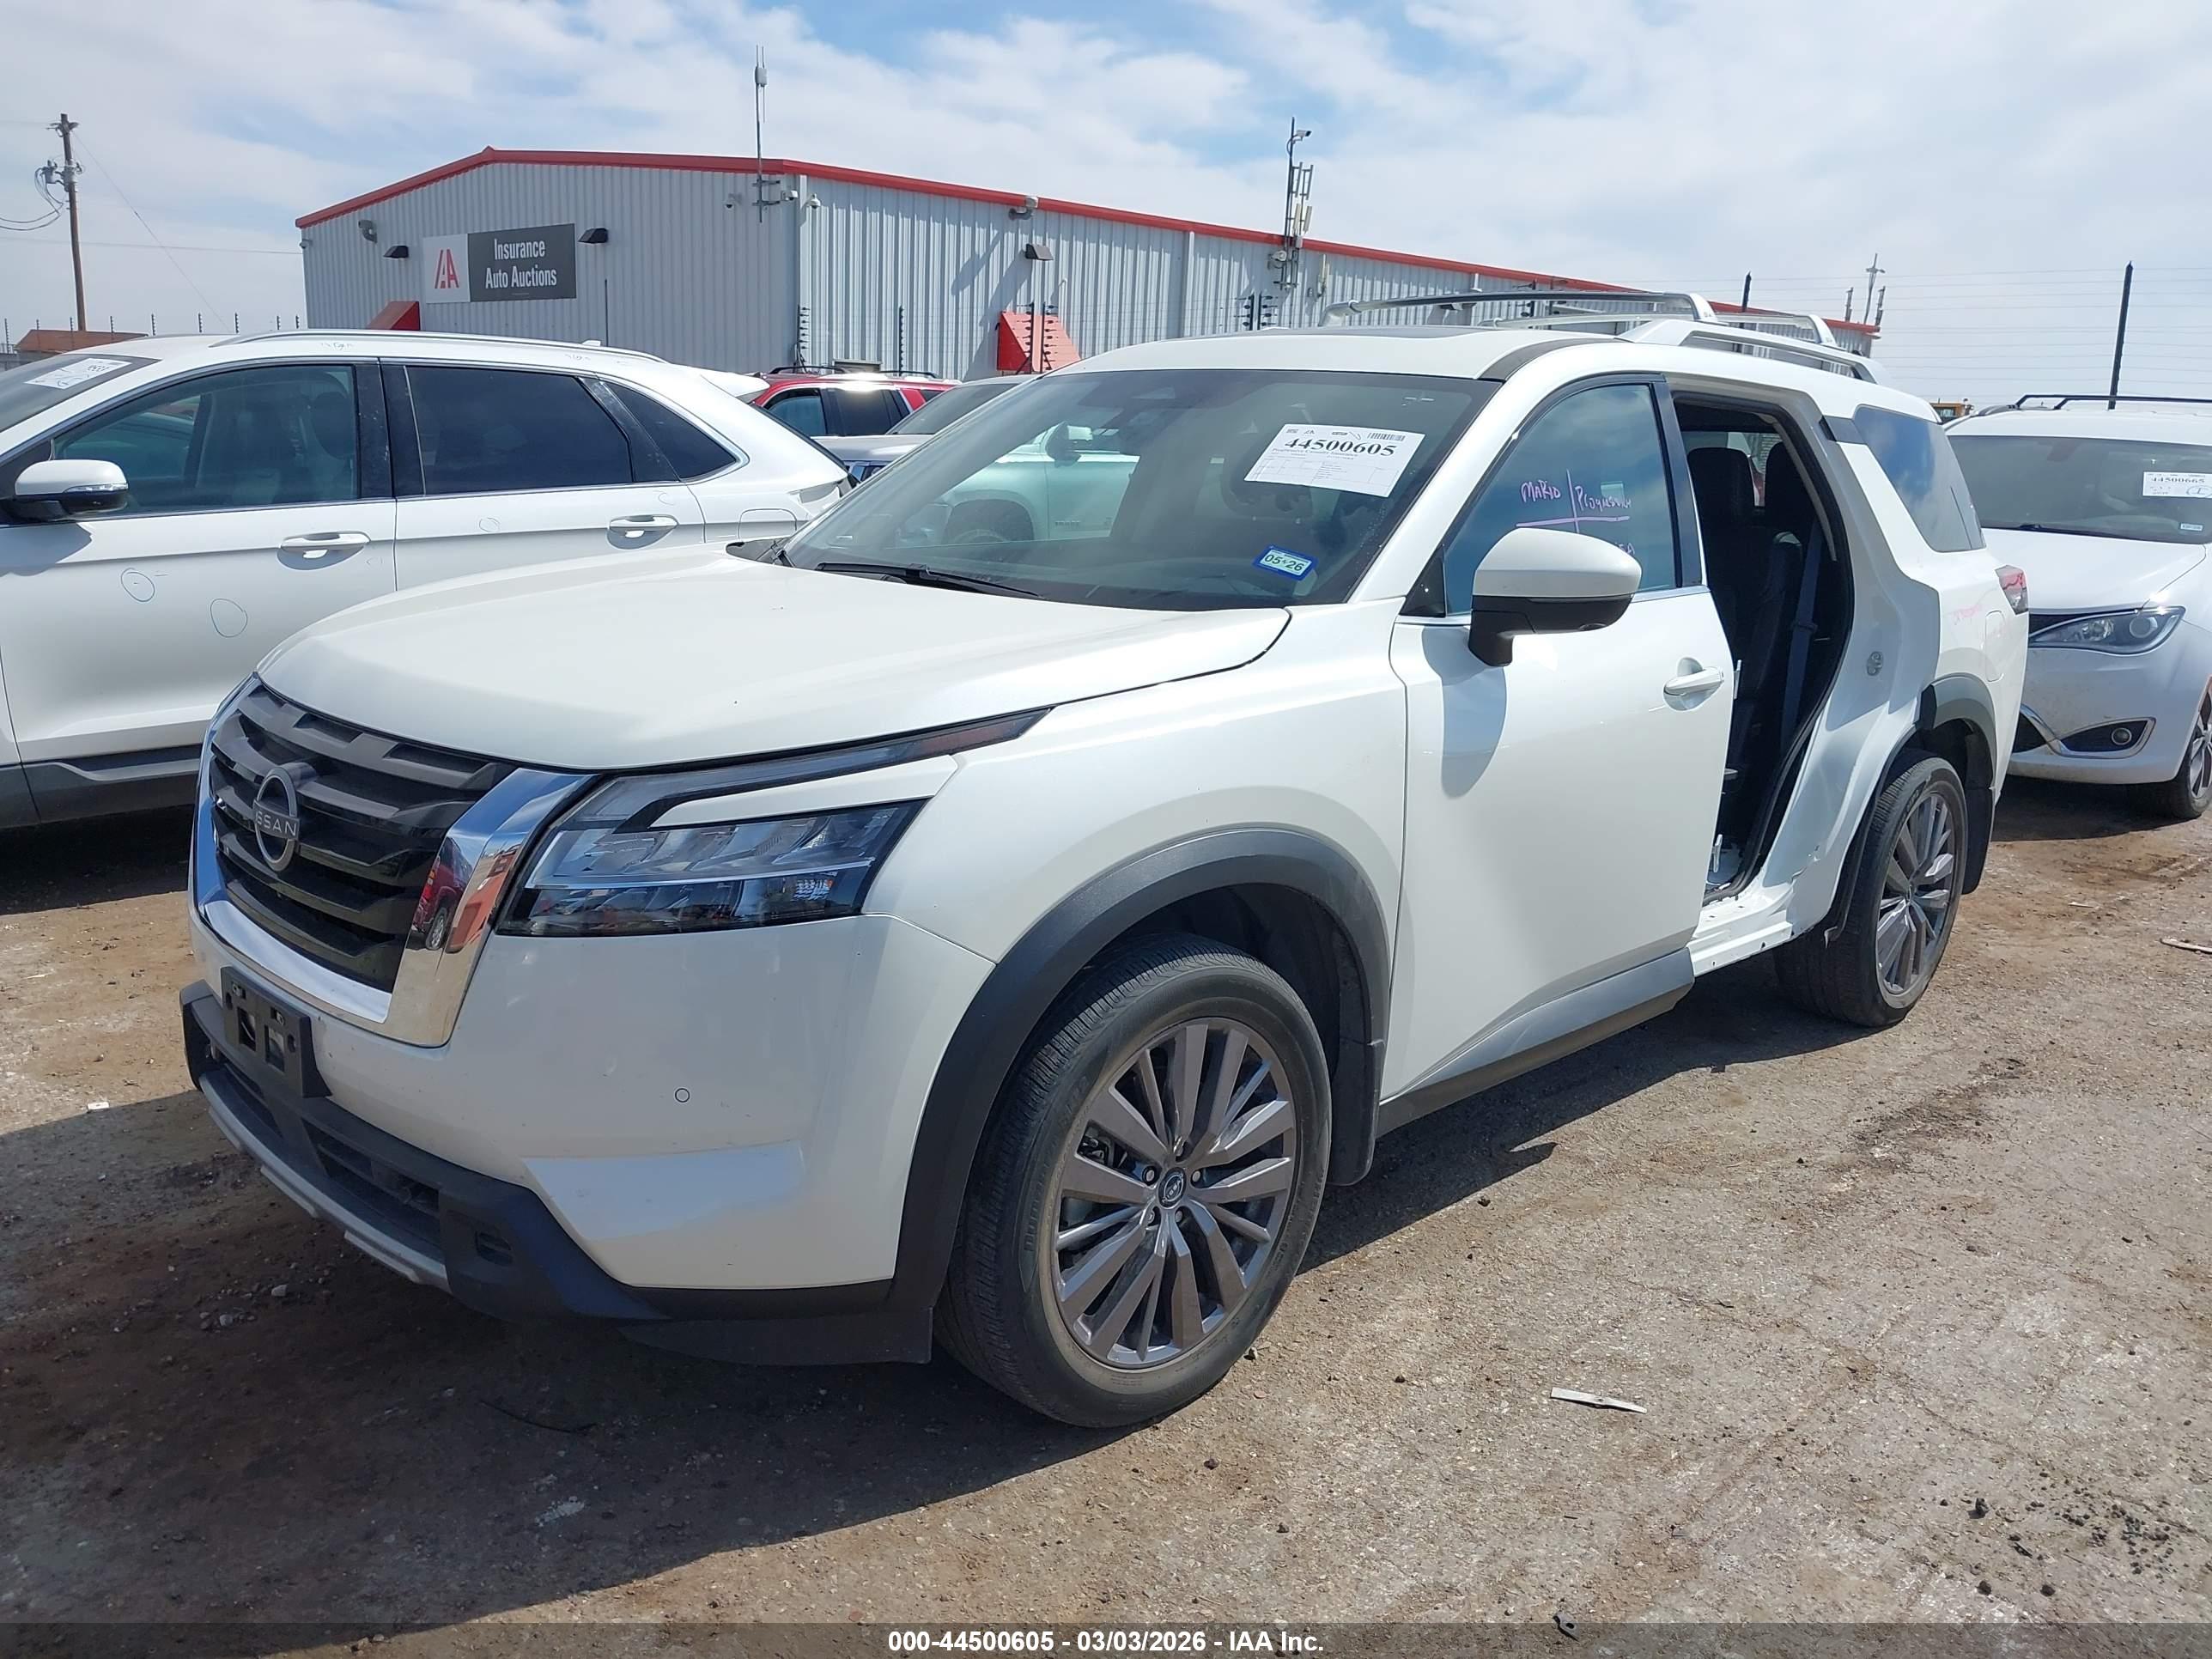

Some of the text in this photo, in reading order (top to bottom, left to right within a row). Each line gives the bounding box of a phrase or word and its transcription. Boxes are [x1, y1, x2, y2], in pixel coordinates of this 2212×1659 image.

[494, 238, 546, 260] Insurance
[485, 264, 557, 289] Auto Auctions
[1284, 438, 1397, 457] 44500605
